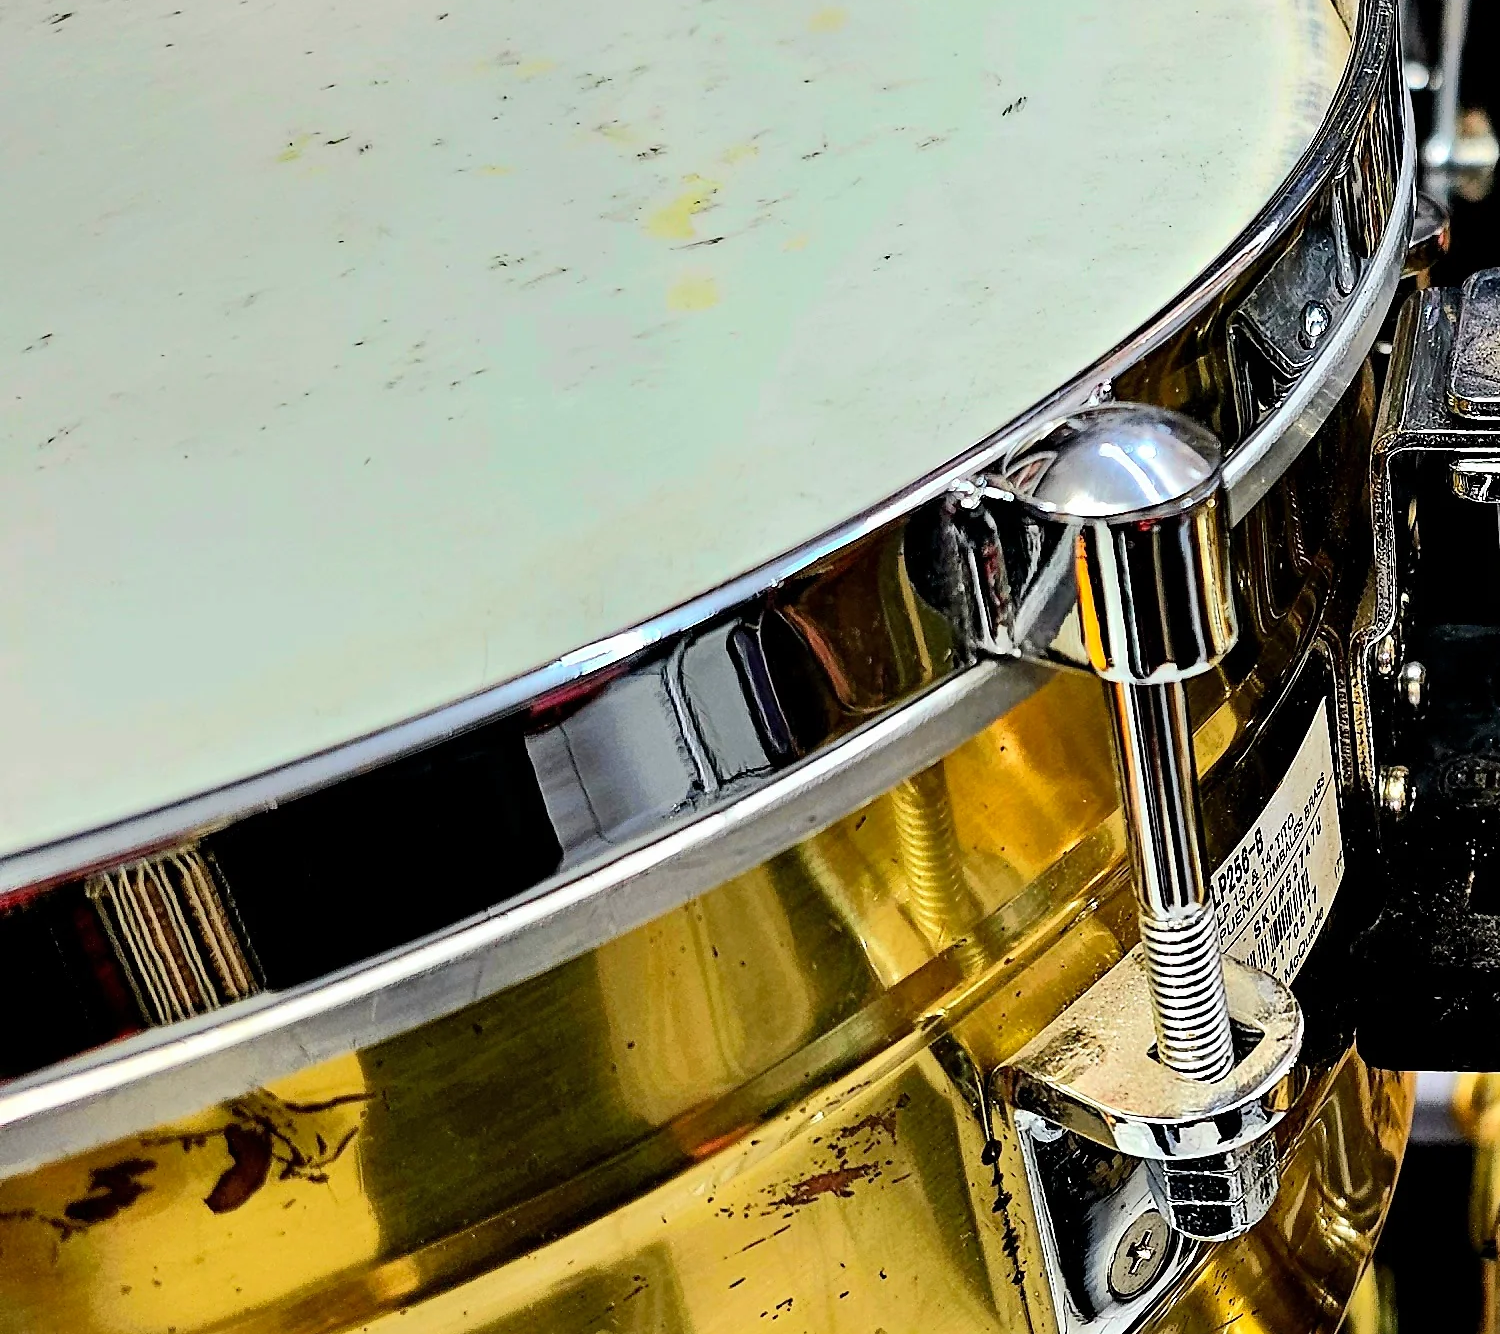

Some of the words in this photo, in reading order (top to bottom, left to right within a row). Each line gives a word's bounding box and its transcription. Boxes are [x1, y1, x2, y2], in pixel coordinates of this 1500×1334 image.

[1211, 827, 1264, 912] LP256-B
[1216, 902, 1231, 929] LP
[1251, 868, 1260, 887] &
[1274, 812, 1295, 850] TITO
[1219, 881, 1264, 946] PUENTE
[1262, 816, 1304, 888] TIMBALES
